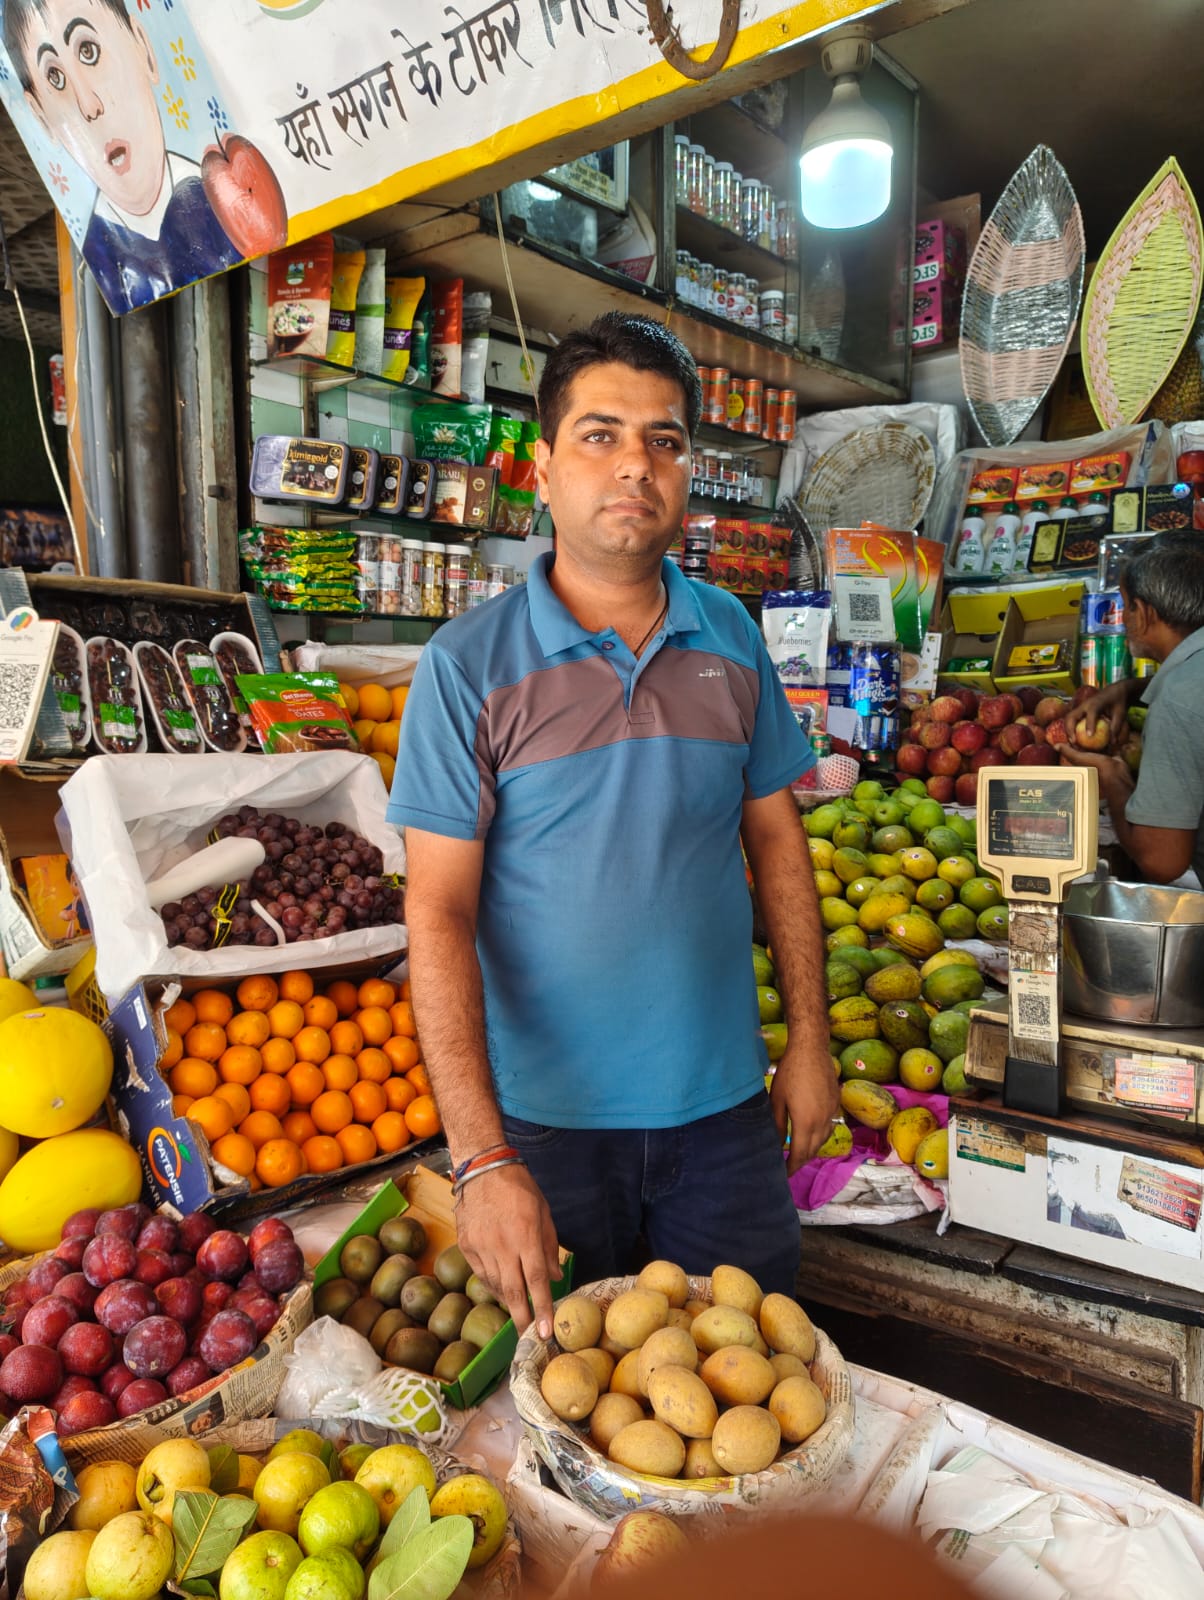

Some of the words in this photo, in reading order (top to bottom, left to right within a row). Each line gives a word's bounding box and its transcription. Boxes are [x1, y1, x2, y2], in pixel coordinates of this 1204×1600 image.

[275, 82, 333, 171] यहाँ
[390, 29, 443, 109] के
[857, 678, 886, 690] Dark
[1018, 788, 1043, 798] CAS
[1056, 809, 1067, 818] kg
[155, 1138, 184, 1205] PATENSIE
